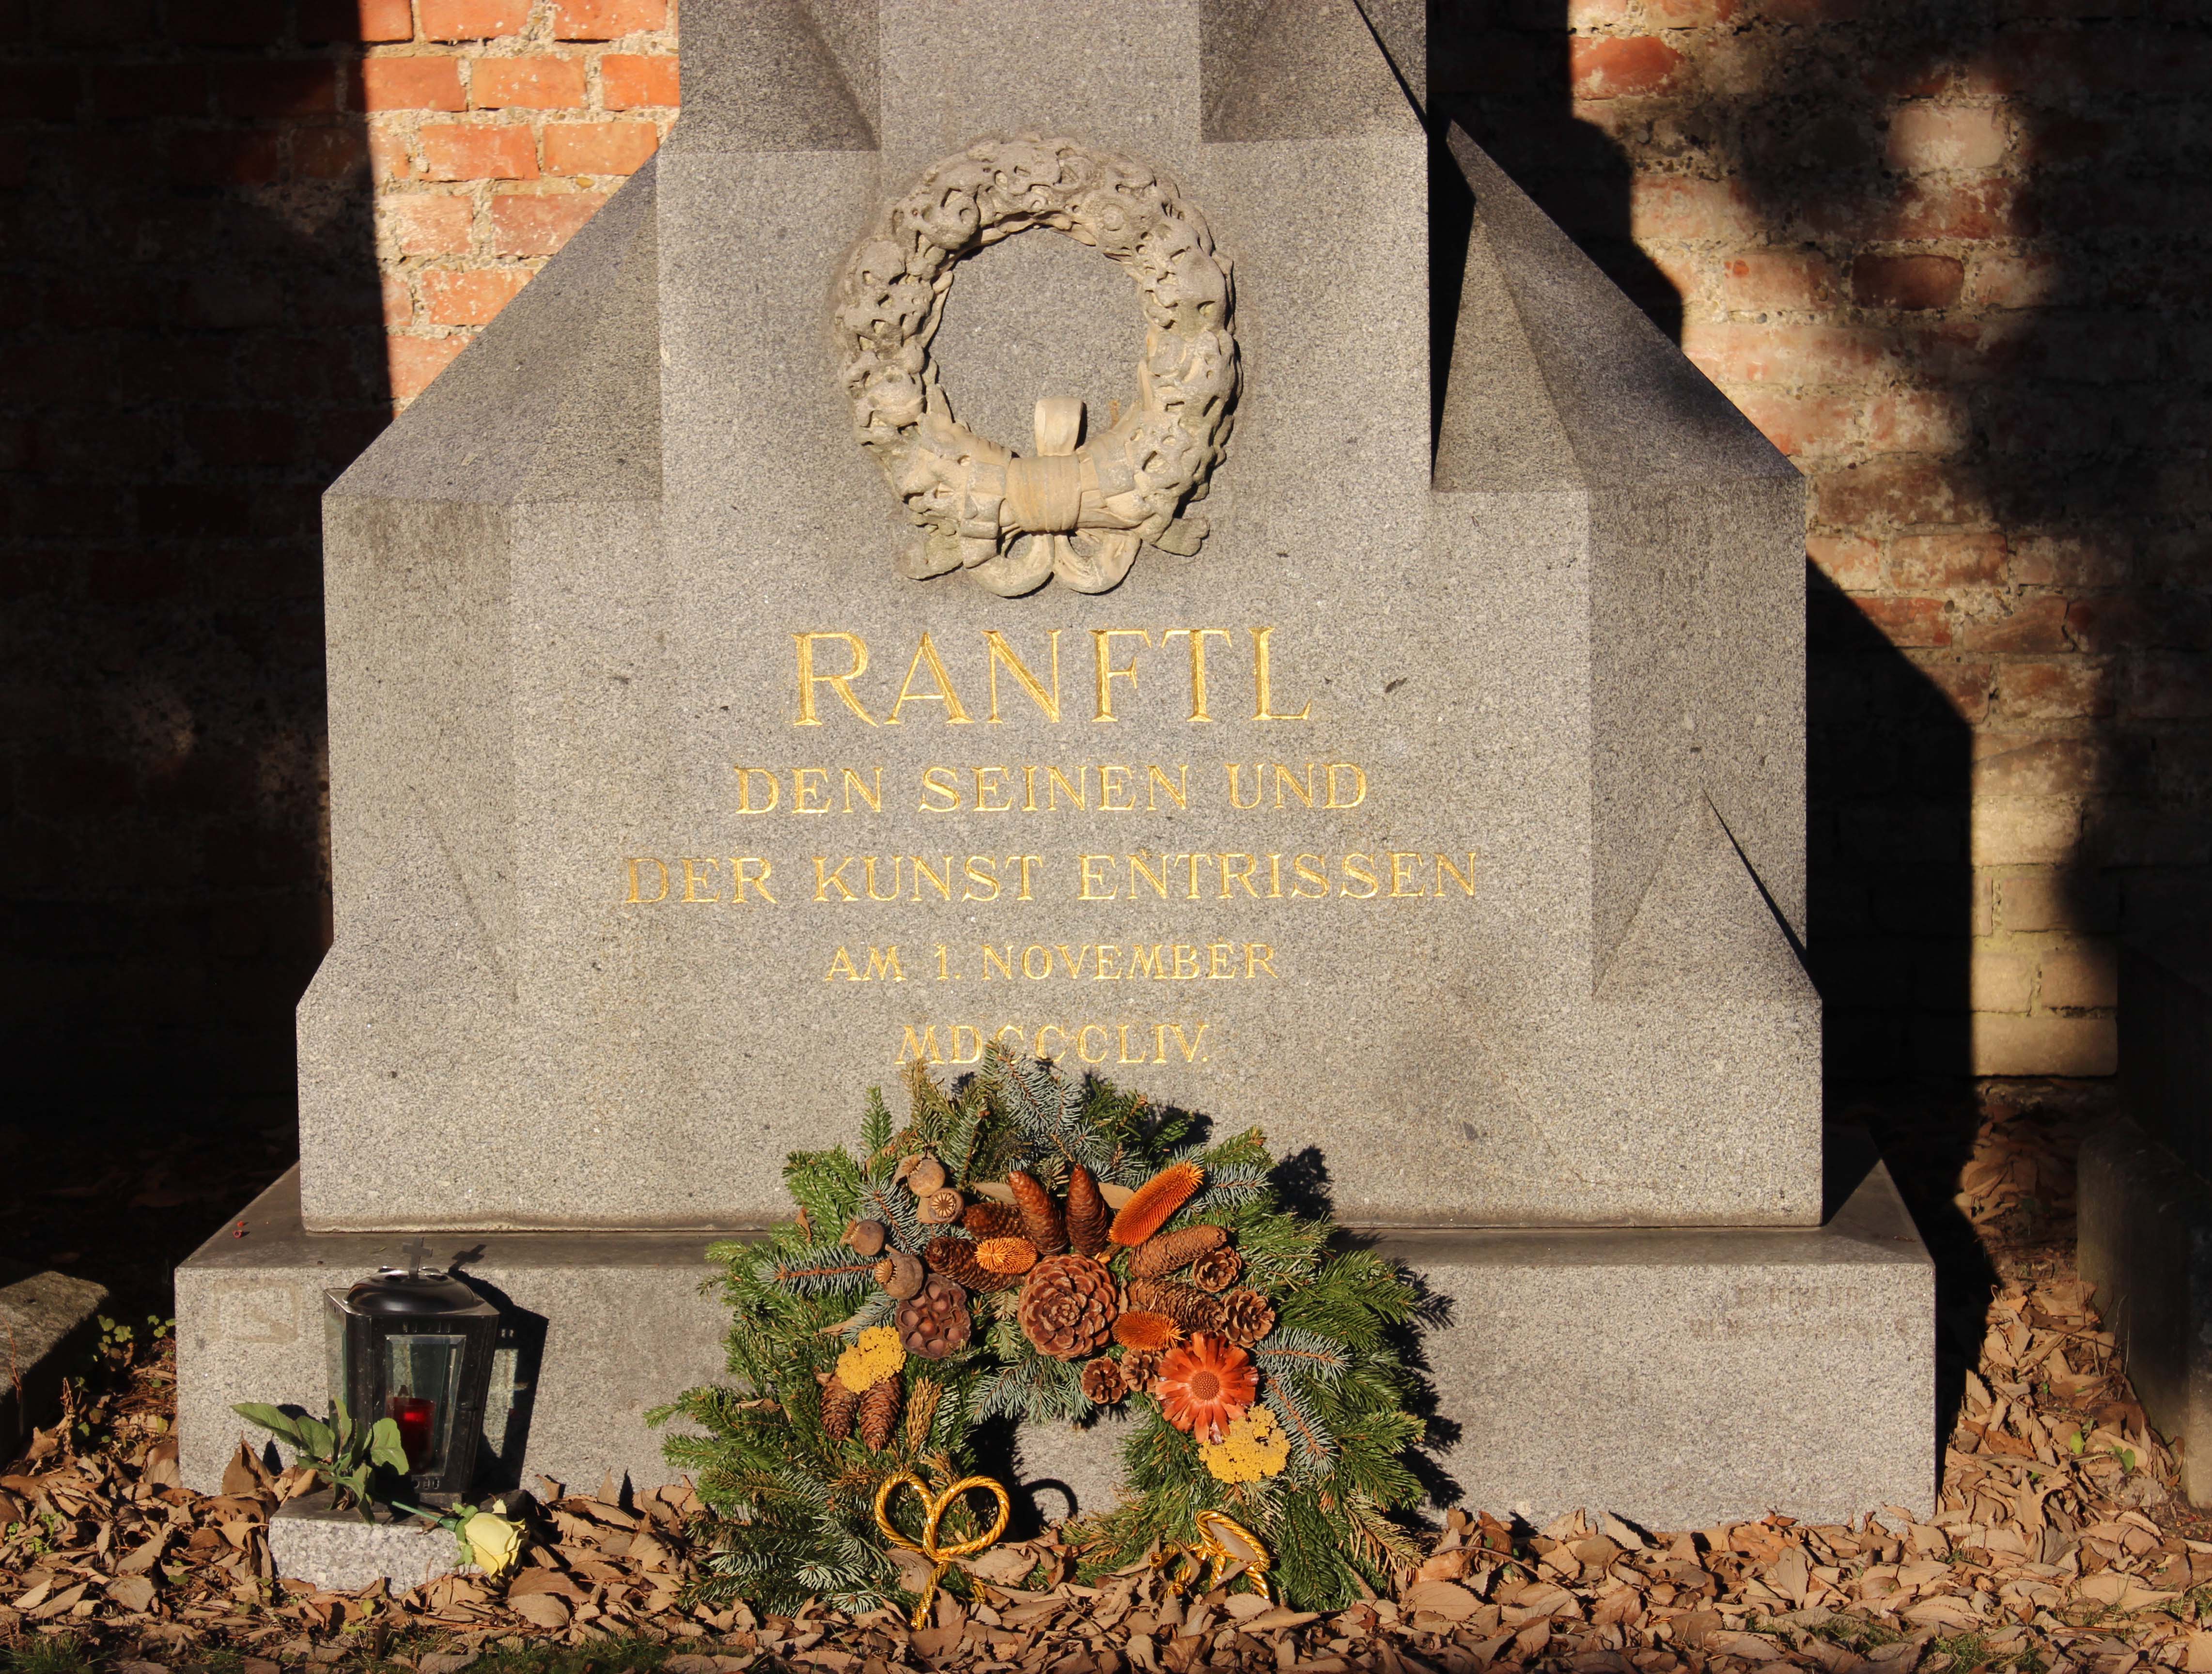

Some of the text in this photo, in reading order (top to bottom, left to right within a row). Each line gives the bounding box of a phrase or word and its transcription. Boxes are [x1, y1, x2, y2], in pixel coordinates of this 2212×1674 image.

[793, 626, 1311, 726] RANFTL
[735, 761, 1368, 814] DEN SEINEN UND
[626, 852, 1476, 904] DER KUNST ENTRISSEN
[826, 943, 1278, 982] AM 1. NOVEMBER
